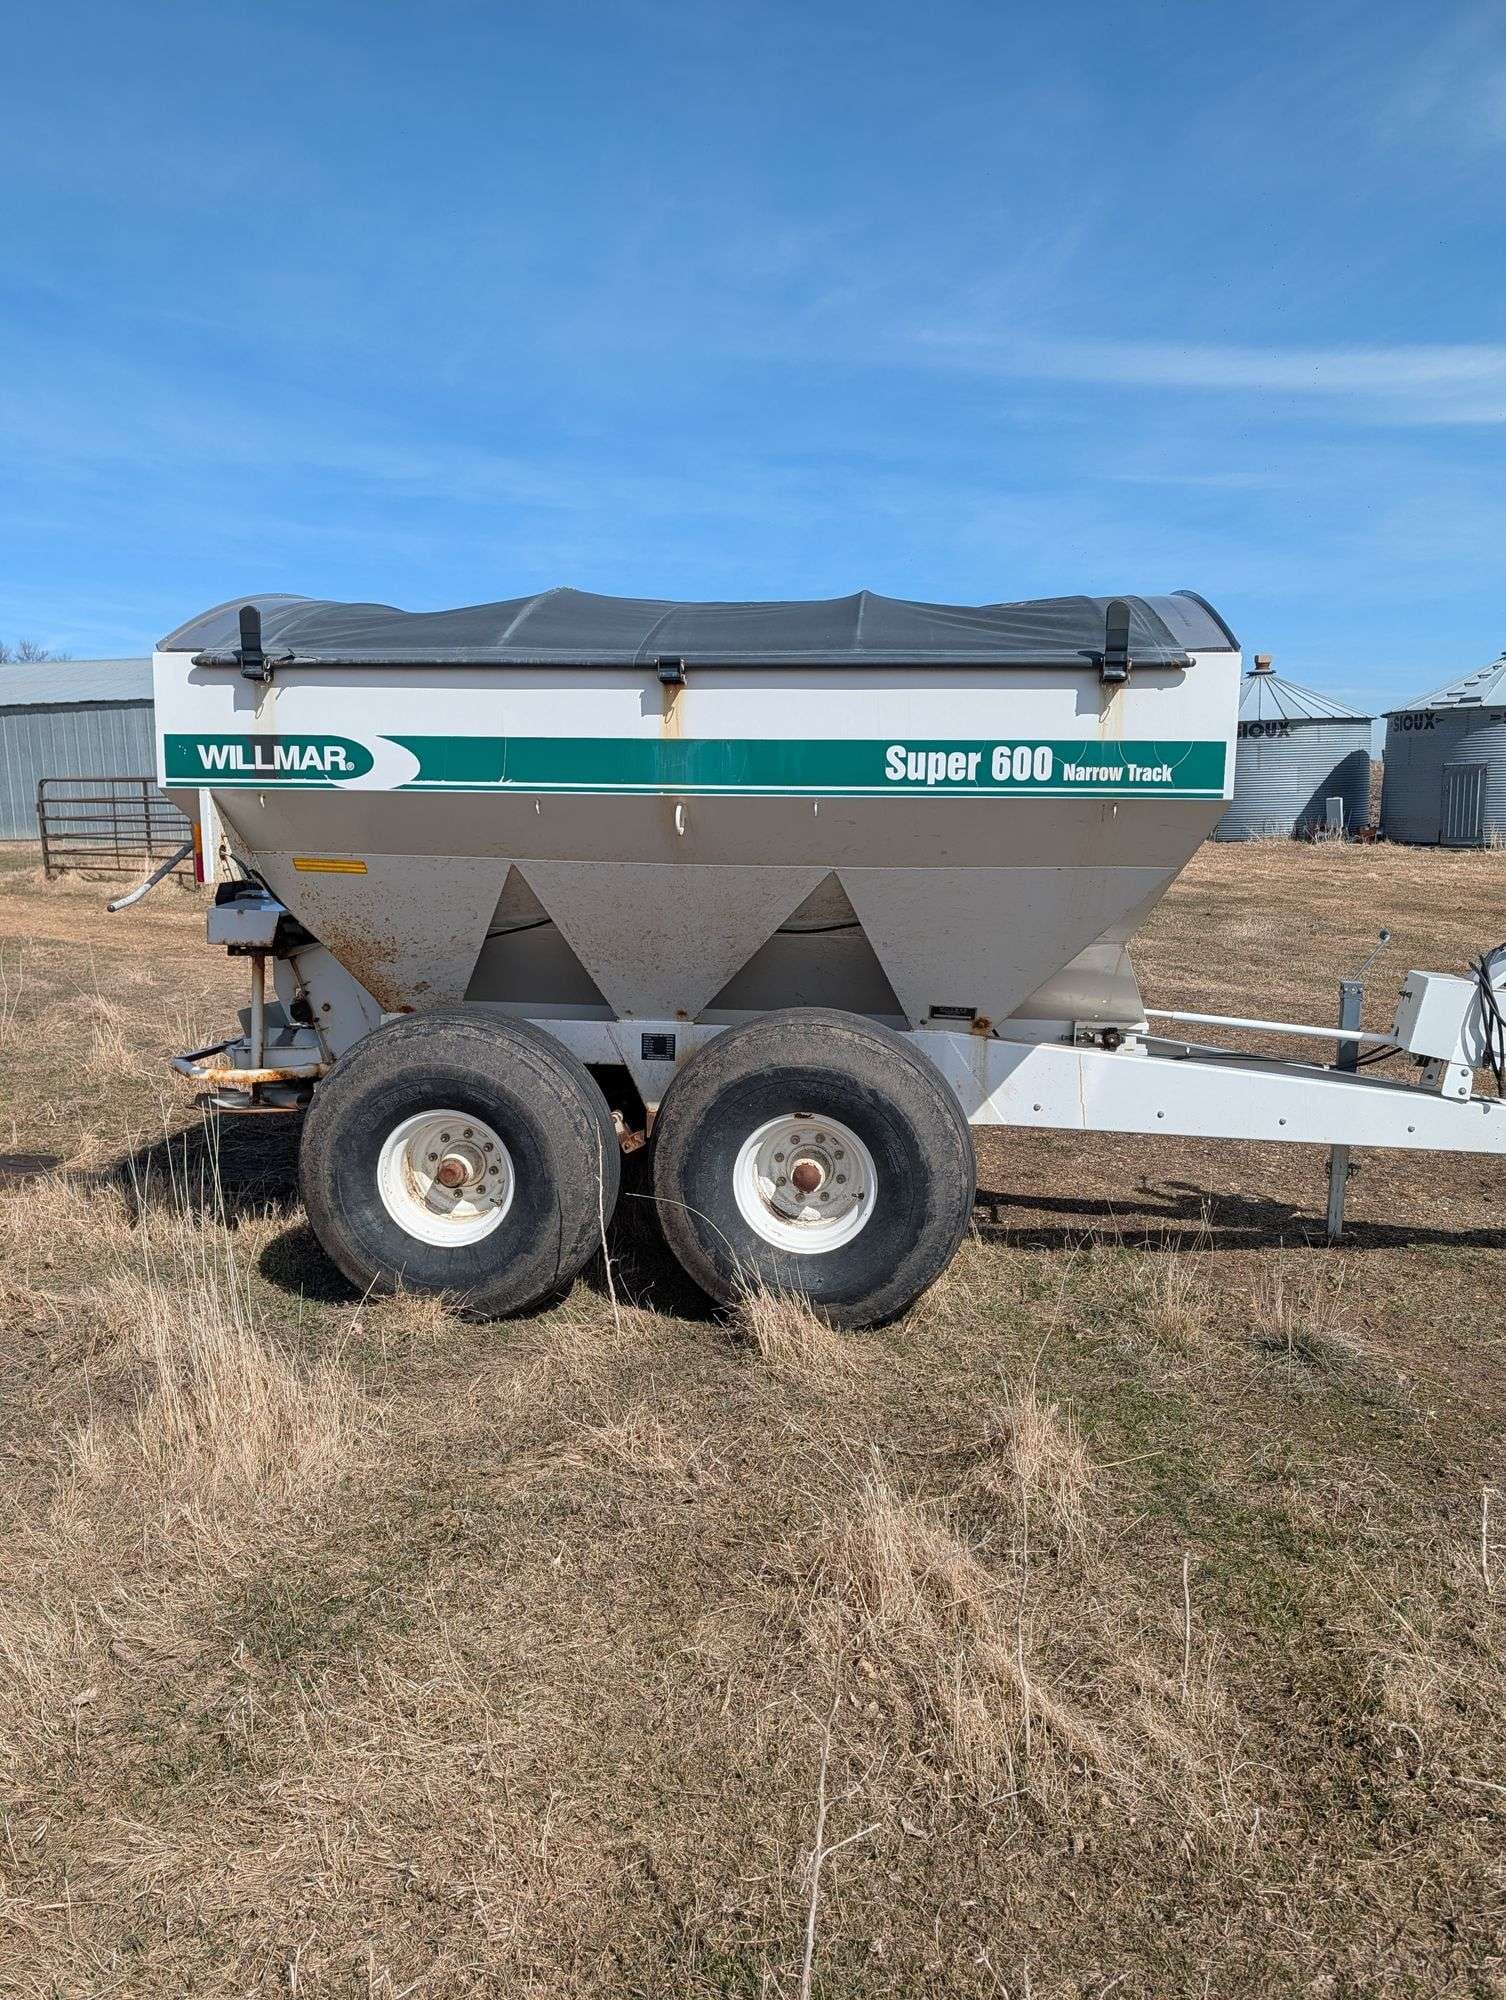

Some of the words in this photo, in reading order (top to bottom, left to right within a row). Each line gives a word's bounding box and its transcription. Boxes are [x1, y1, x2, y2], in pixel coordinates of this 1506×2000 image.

[1393, 711, 1436, 732] SIOUX
[885, 745, 981, 784] Super
[991, 746, 1053, 782] 600
[1063, 764, 1124, 782] Narrow
[1127, 764, 1173, 783] Track
